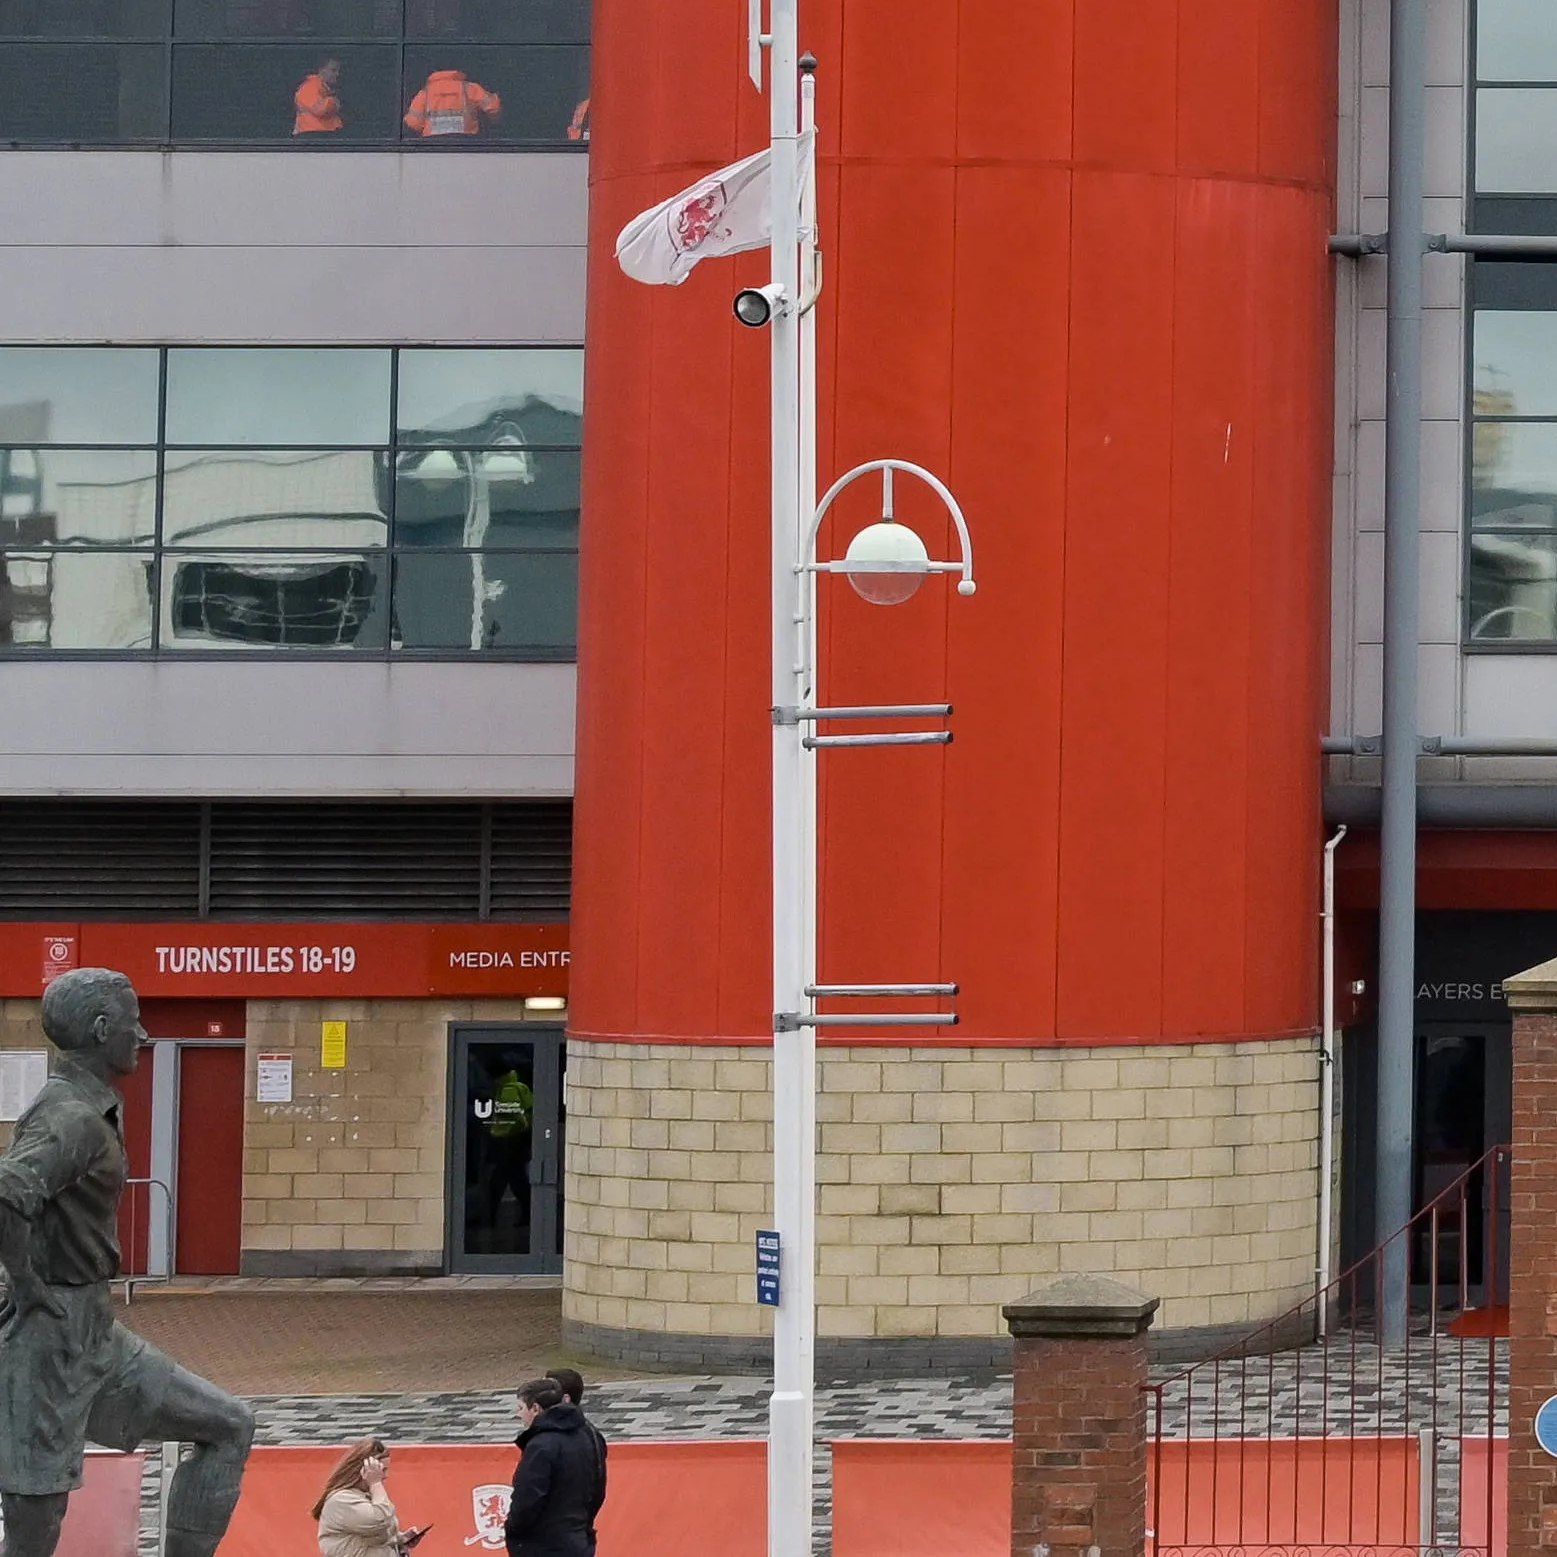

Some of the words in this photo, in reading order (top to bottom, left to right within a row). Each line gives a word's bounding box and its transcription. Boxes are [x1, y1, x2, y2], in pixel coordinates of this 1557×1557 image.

[155, 946, 294, 974] TURNSTILES
[299, 946, 356, 974] 18-19
[449, 951, 514, 968] MEDIA
[520, 951, 571, 968] ENTR
[1414, 983, 1484, 1000] AYERS
